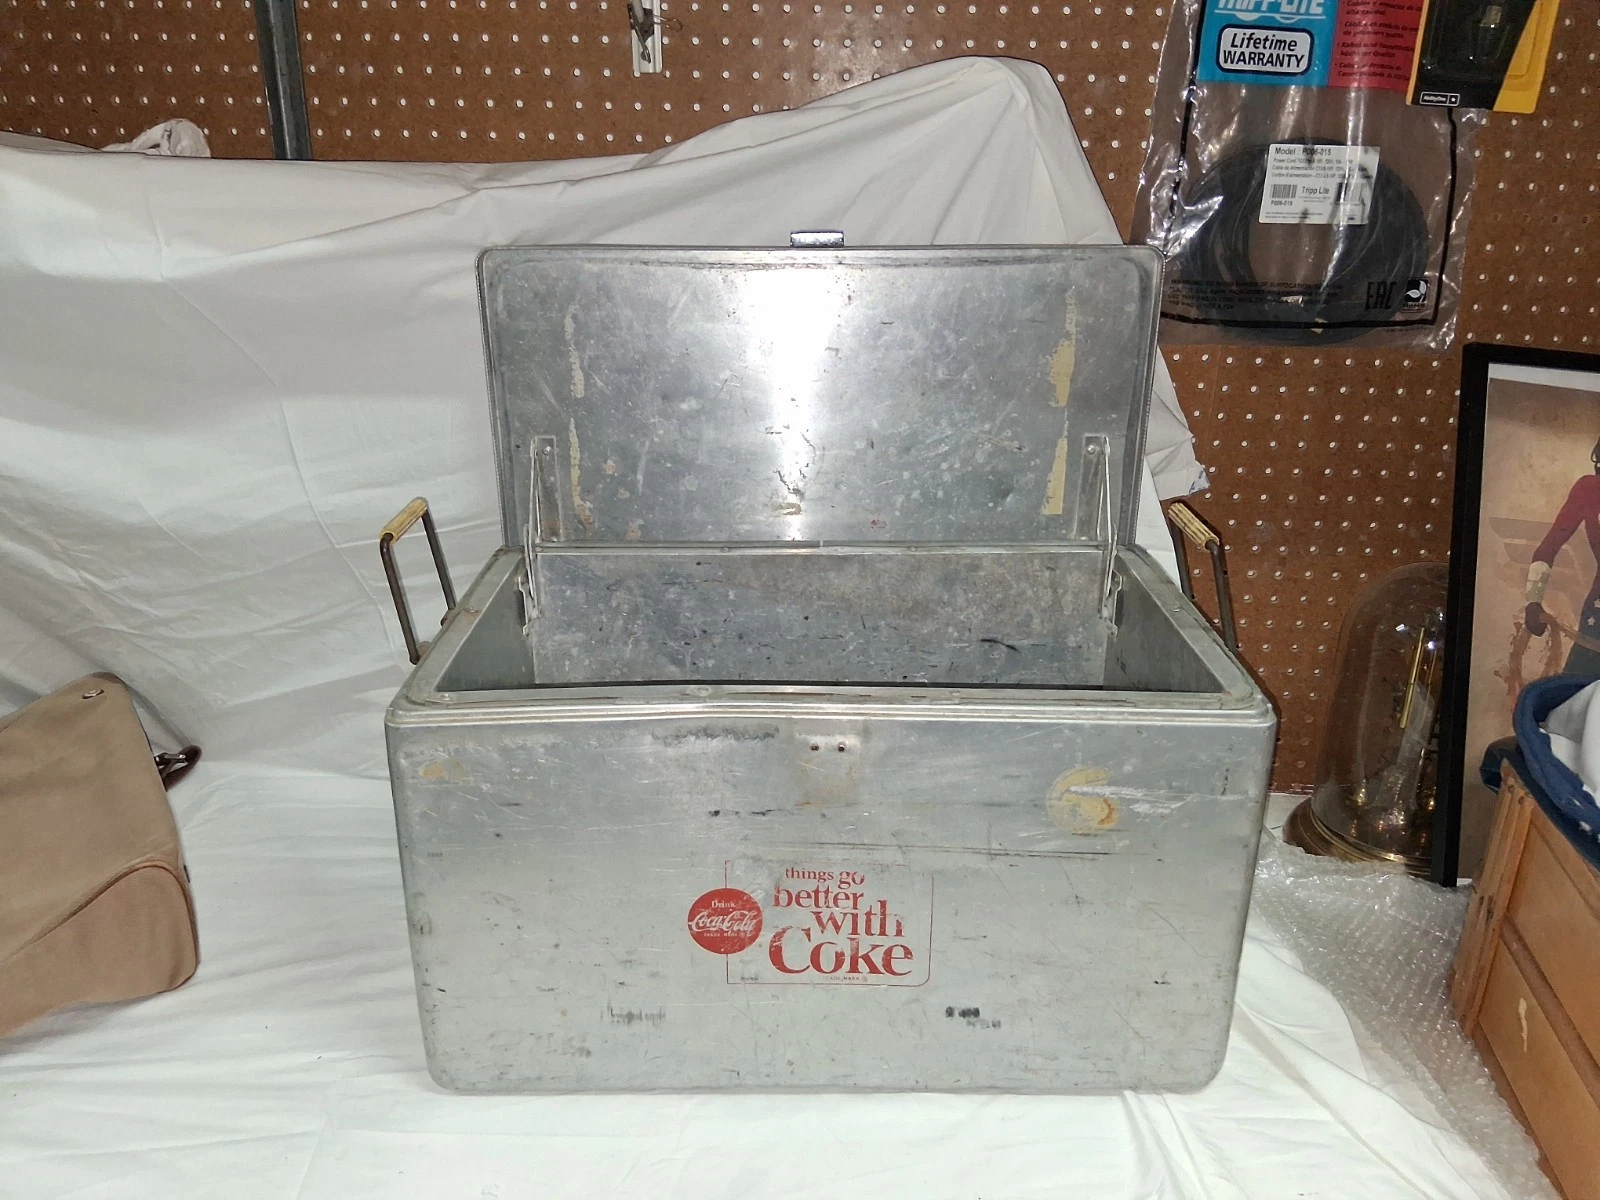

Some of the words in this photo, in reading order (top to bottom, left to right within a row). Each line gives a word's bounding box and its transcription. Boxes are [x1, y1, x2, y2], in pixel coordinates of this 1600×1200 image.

[1230, 32, 1298, 51] Lifetime
[1223, 49, 1305, 68] WARRANTY
[1275, 147, 1296, 155] Model
[1302, 186, 1318, 195] Tripp
[785, 867, 834, 884] things
[839, 870, 865, 890] go
[711, 899, 737, 908] Drink
[772, 884, 864, 910] better
[810, 899, 905, 937] with
[768, 926, 914, 977] Coke
